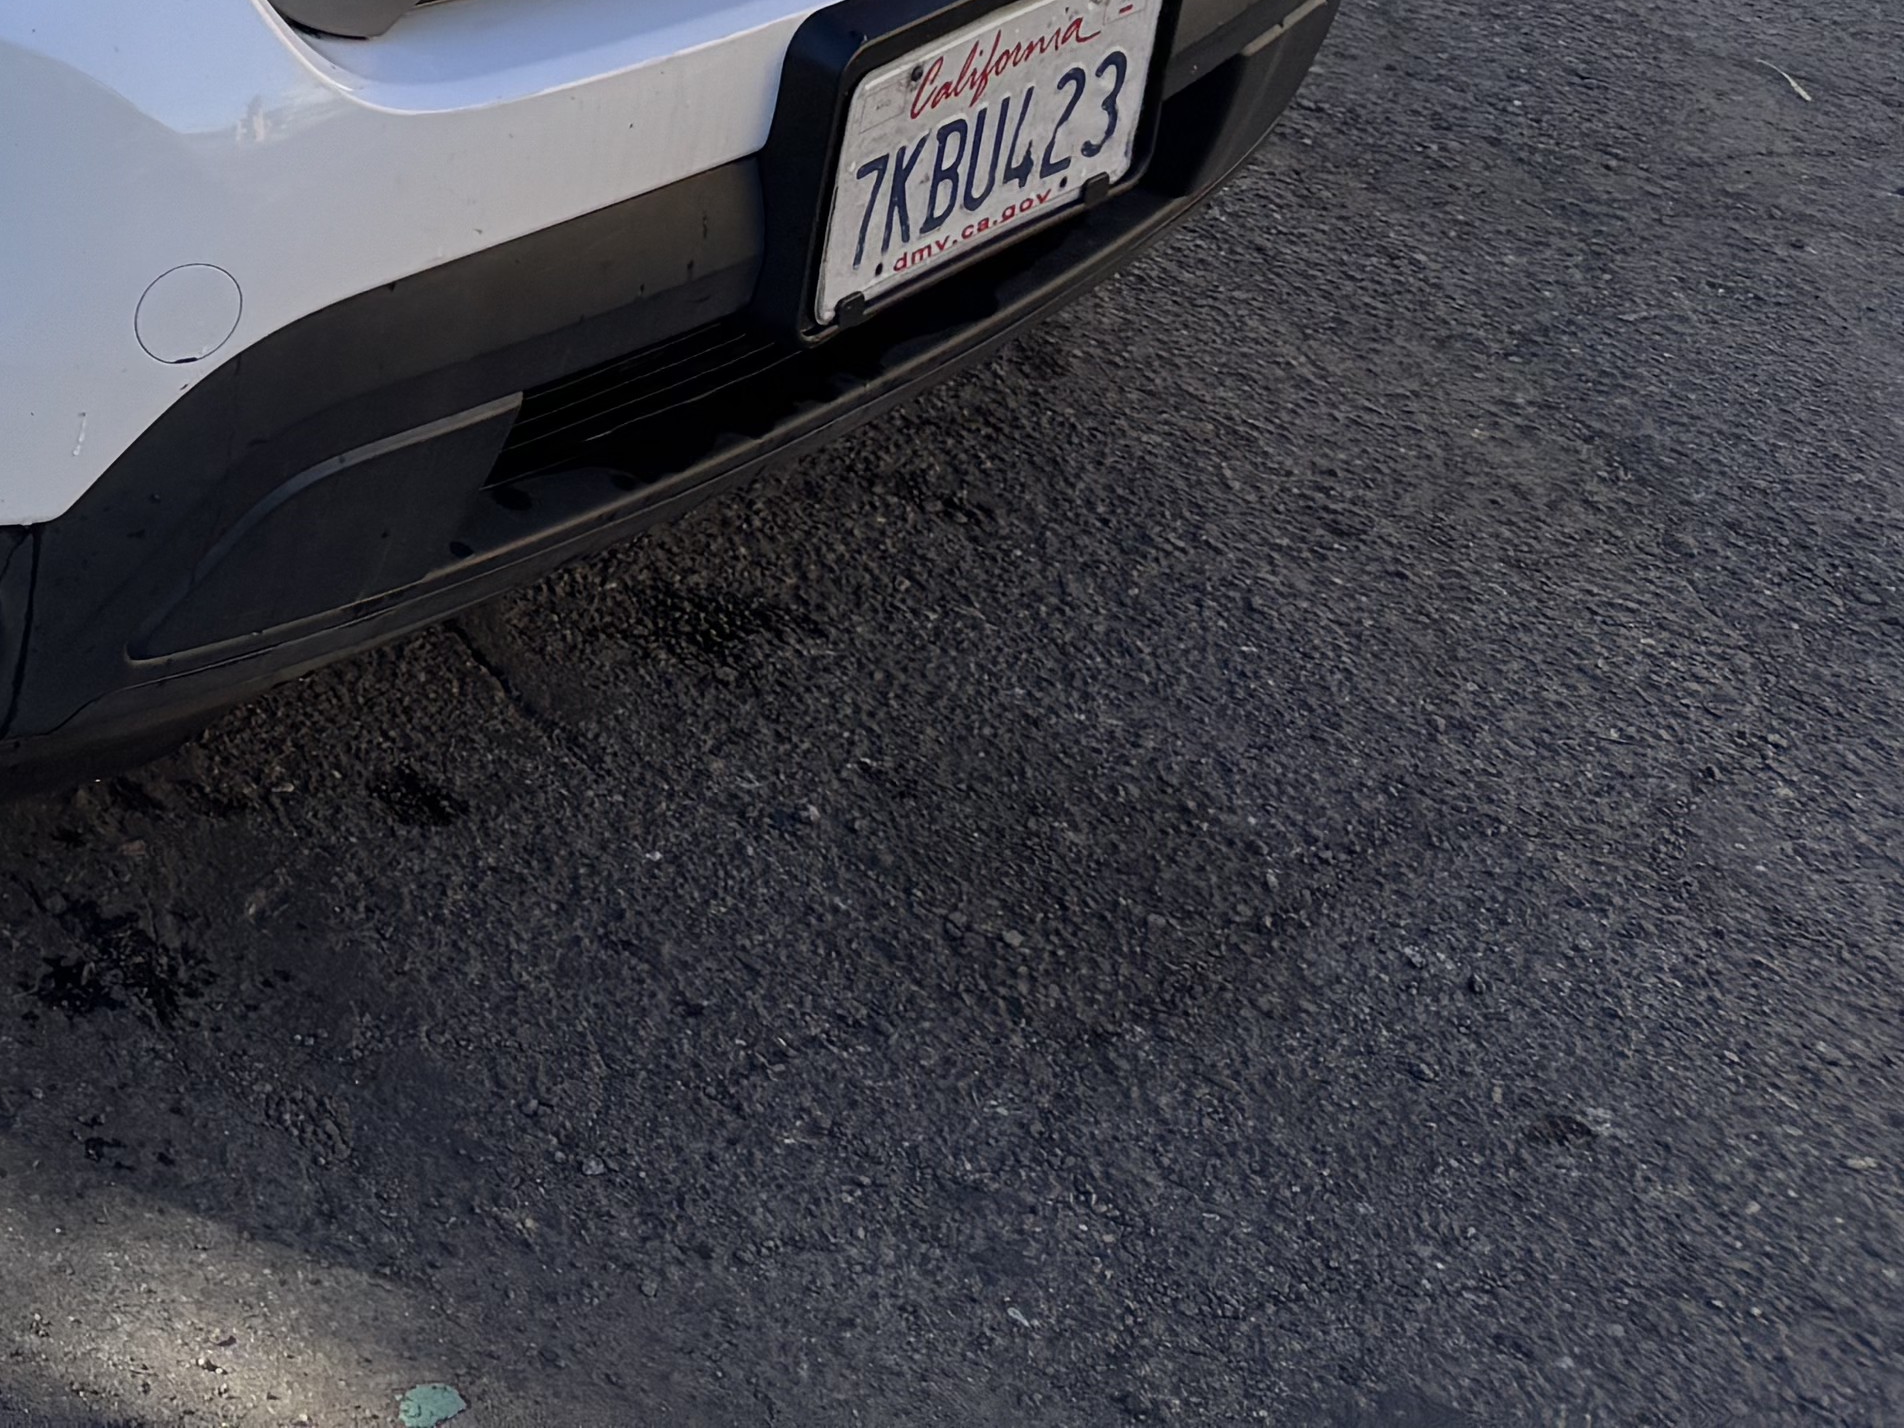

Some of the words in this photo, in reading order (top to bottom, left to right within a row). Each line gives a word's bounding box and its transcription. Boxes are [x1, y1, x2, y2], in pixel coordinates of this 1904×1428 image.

[910, 12, 1101, 119] California
[852, 50, 1128, 269] 7KBU423
[893, 188, 1052, 273] dmv.ca.gov
